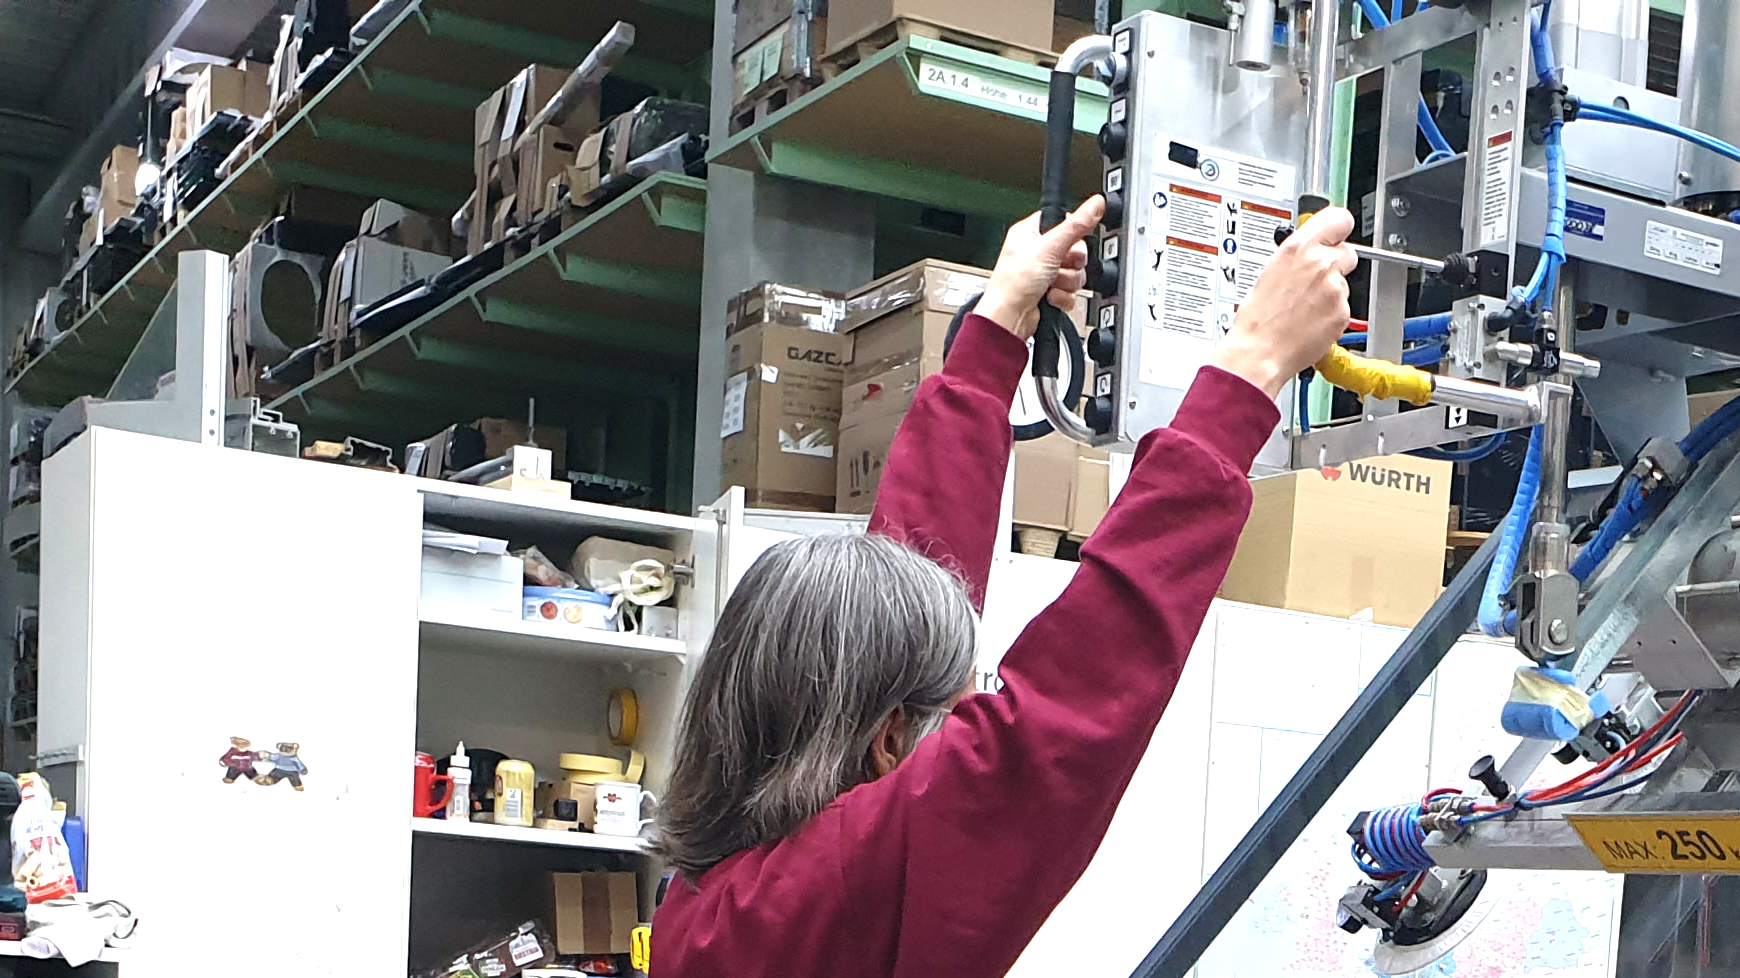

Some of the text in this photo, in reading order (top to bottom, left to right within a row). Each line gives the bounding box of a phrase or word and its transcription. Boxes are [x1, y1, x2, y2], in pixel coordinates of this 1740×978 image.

[787, 346, 843, 366] GAZC
[1349, 462, 1431, 495] WÜRTH
[1656, 829, 1727, 861] 250
